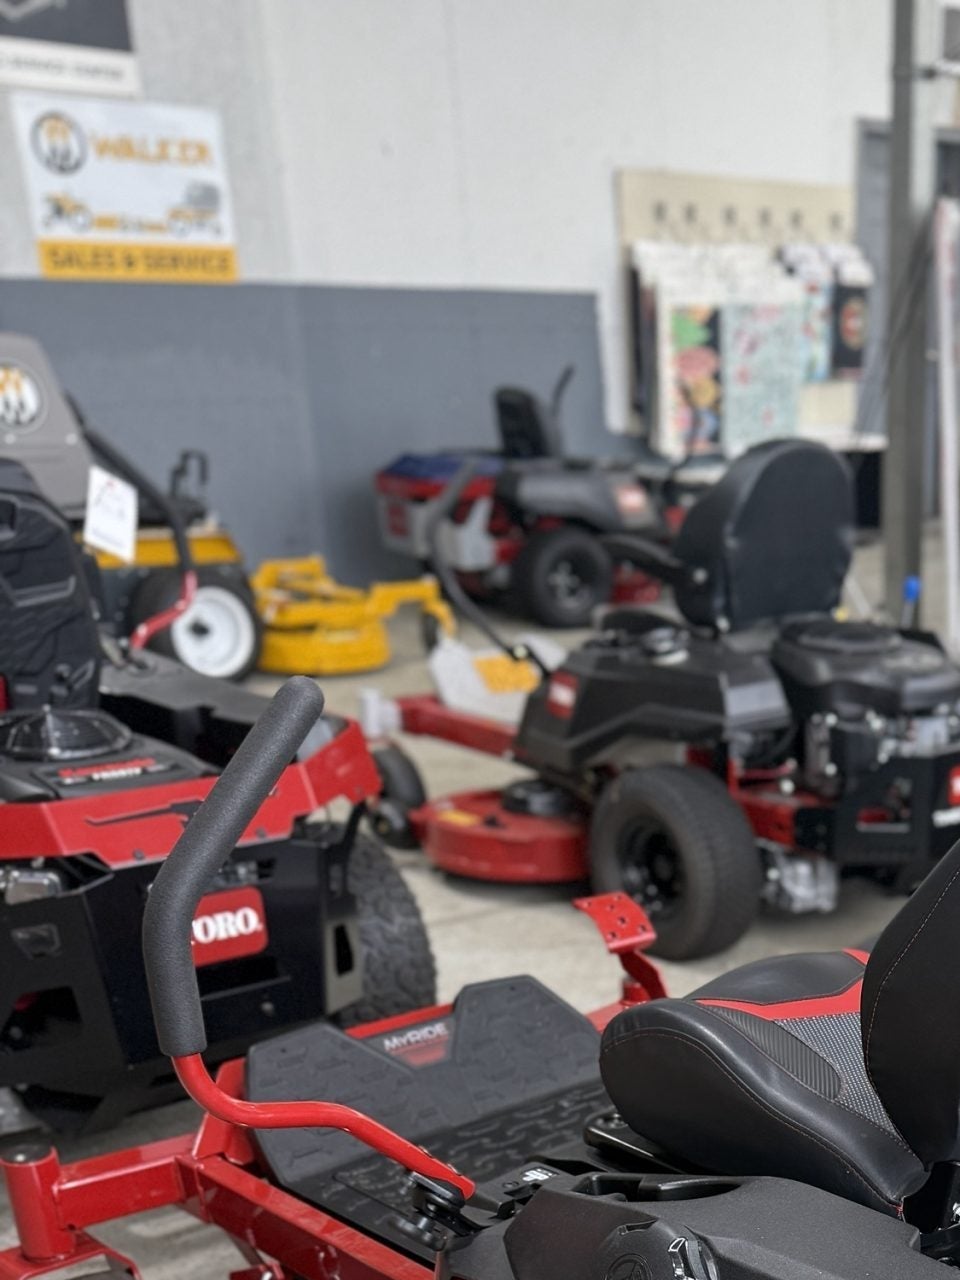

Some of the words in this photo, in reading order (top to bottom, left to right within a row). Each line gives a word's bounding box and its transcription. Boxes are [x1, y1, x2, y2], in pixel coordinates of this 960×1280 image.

[51, 247, 116, 269] SALES
[143, 248, 230, 271] SERVICE
[191, 906, 260, 945] ORO
